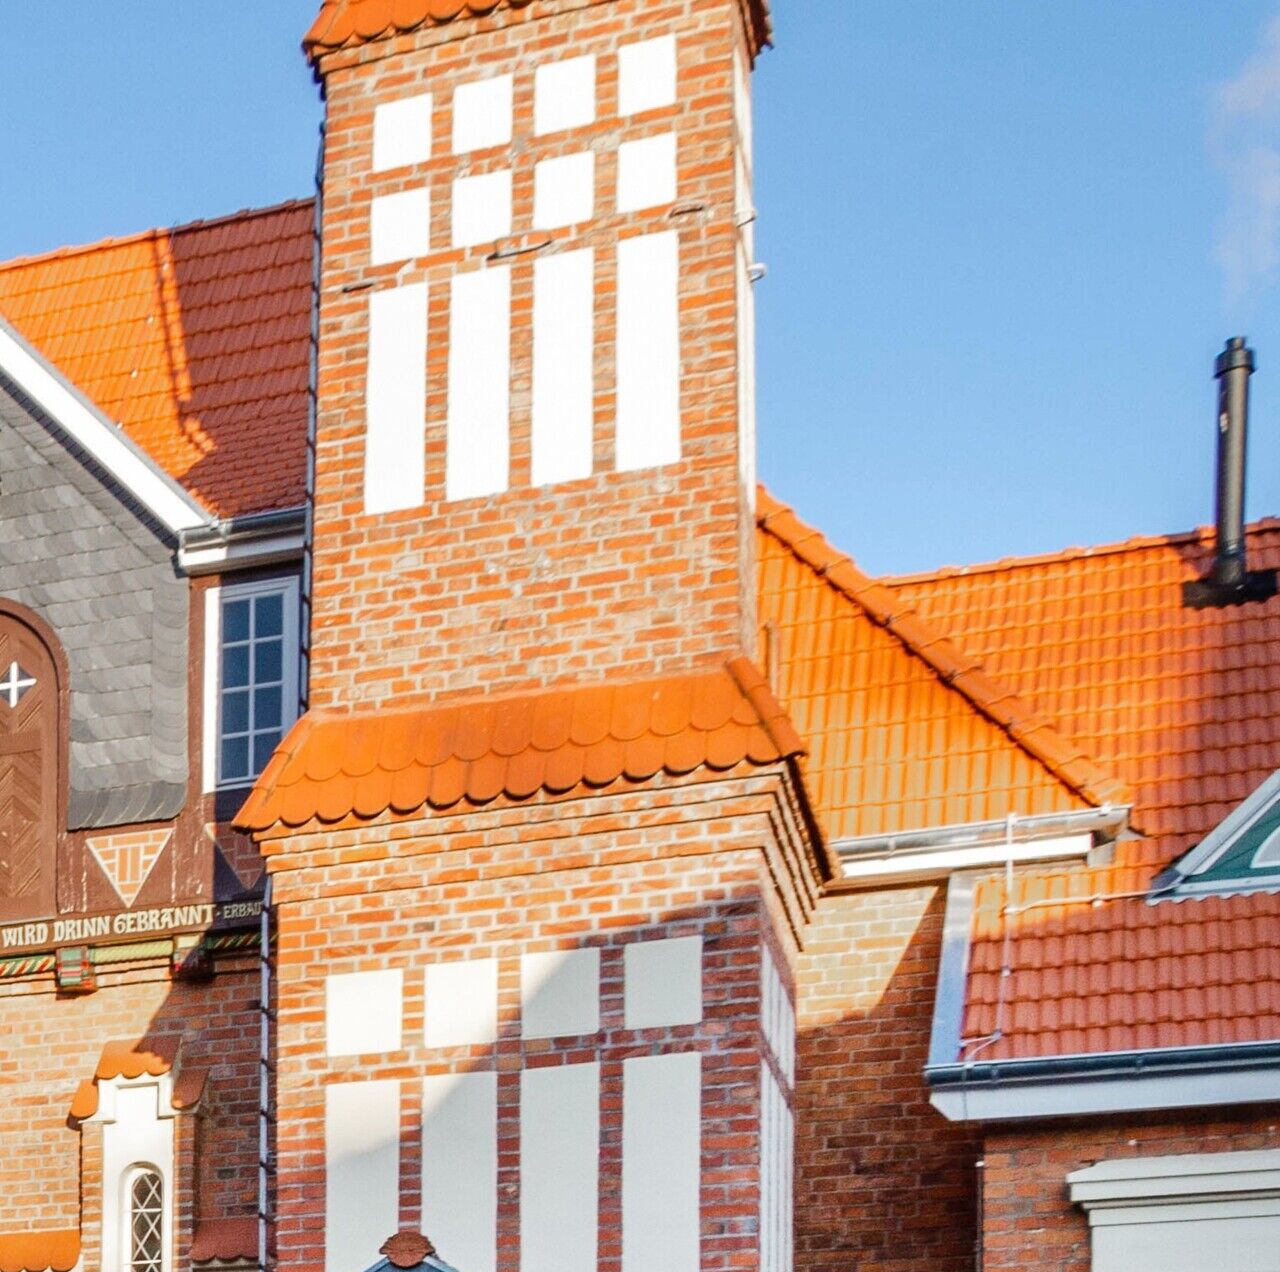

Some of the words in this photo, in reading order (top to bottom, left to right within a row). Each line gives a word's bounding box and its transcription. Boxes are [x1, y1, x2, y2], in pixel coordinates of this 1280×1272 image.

[2, 922, 49, 948] WIRD
[53, 915, 111, 943] DRINN
[113, 903, 216, 934] GEBRANNT
